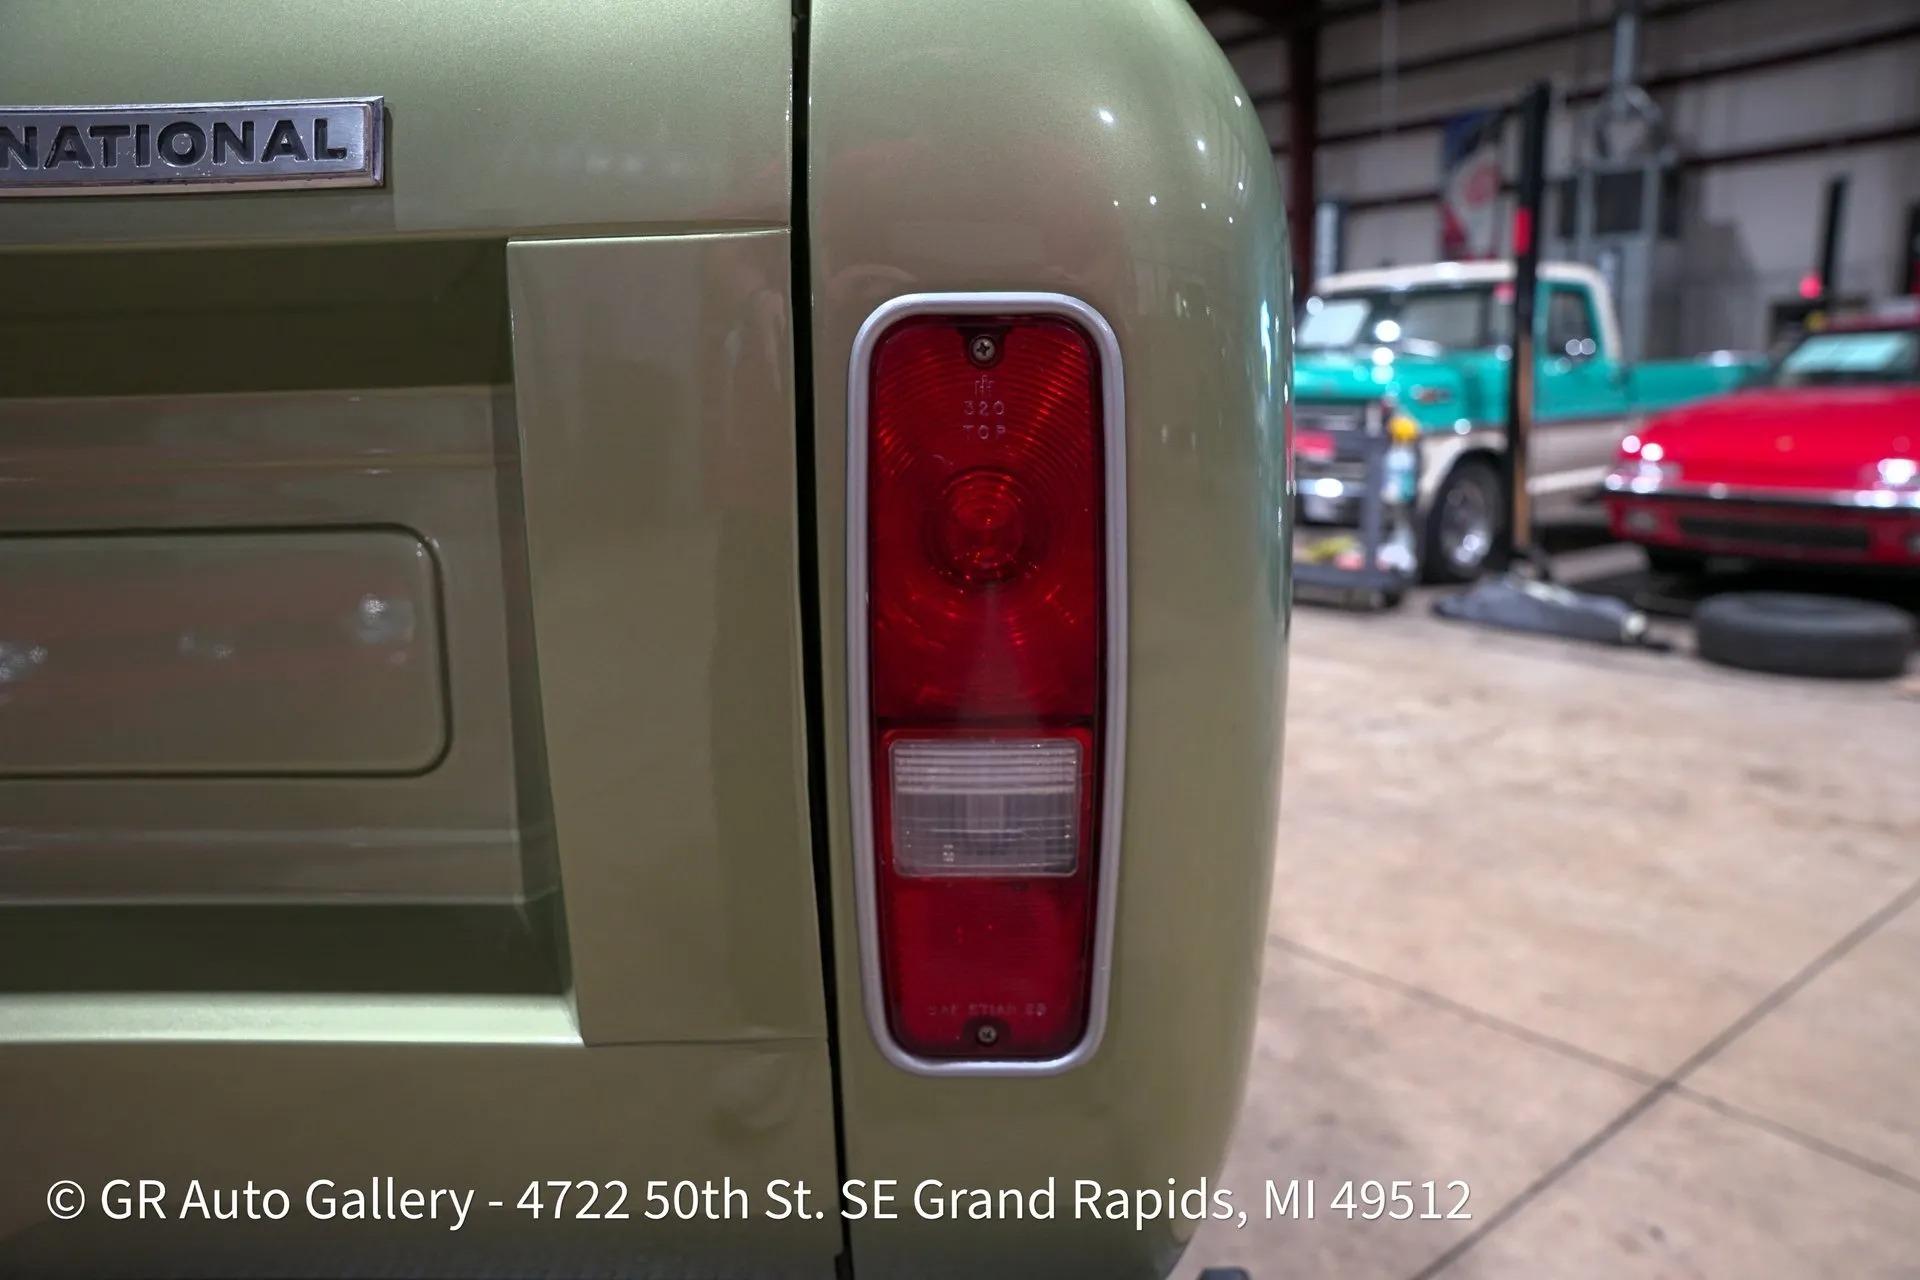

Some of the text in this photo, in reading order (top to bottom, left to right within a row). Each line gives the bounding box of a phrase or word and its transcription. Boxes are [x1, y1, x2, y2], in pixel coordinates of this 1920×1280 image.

[0, 118, 348, 171] NATIONAL
[963, 400, 1005, 416] 320
[962, 424, 1006, 440] TOP
